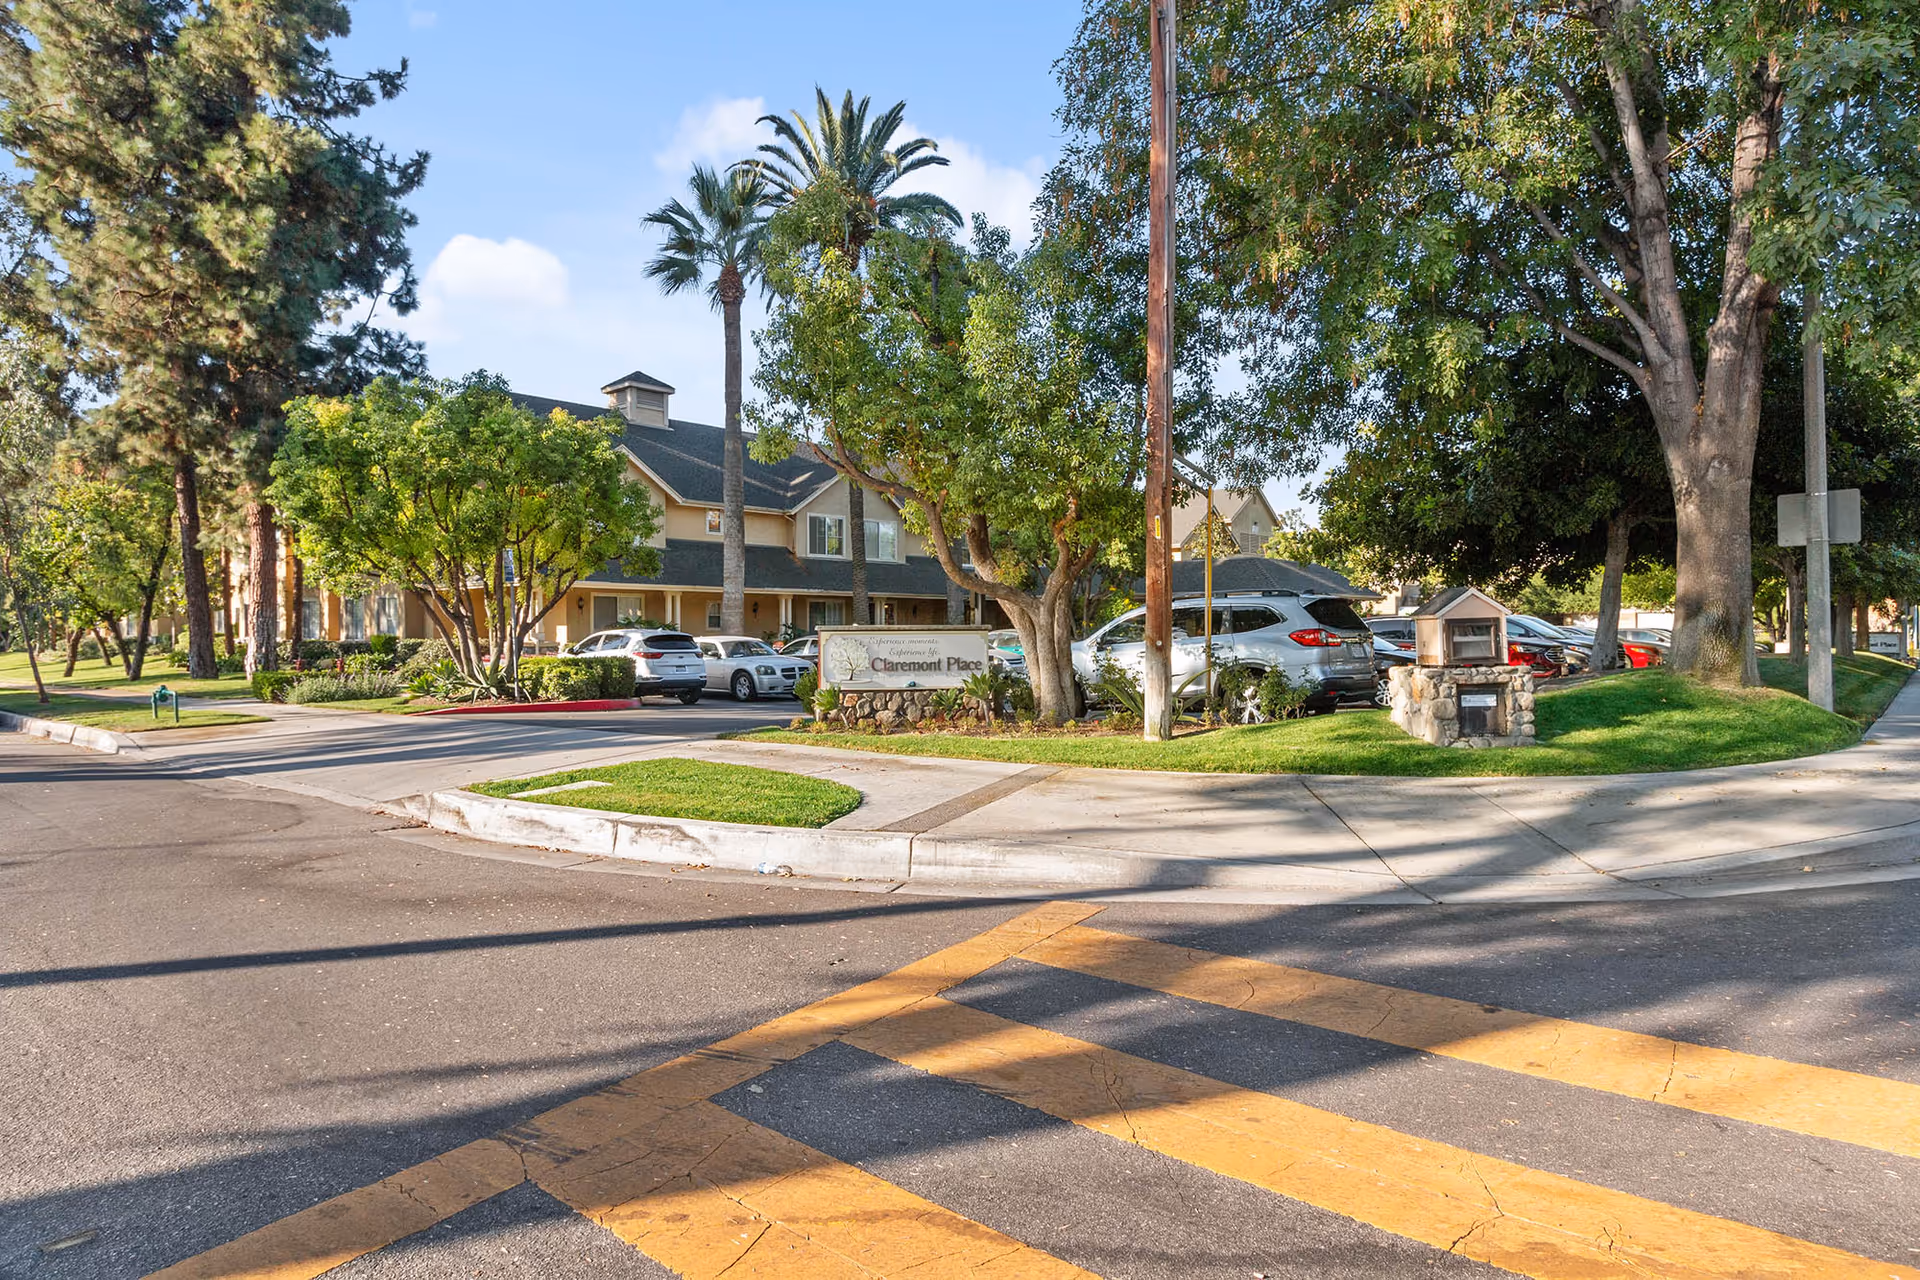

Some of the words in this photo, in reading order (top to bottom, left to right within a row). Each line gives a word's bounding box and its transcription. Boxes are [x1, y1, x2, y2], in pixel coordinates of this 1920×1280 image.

[868, 637, 905, 646] Experience
[889, 649, 926, 658] Experience
[871, 657, 942, 672] Claremont
[946, 657, 983, 671] Place
